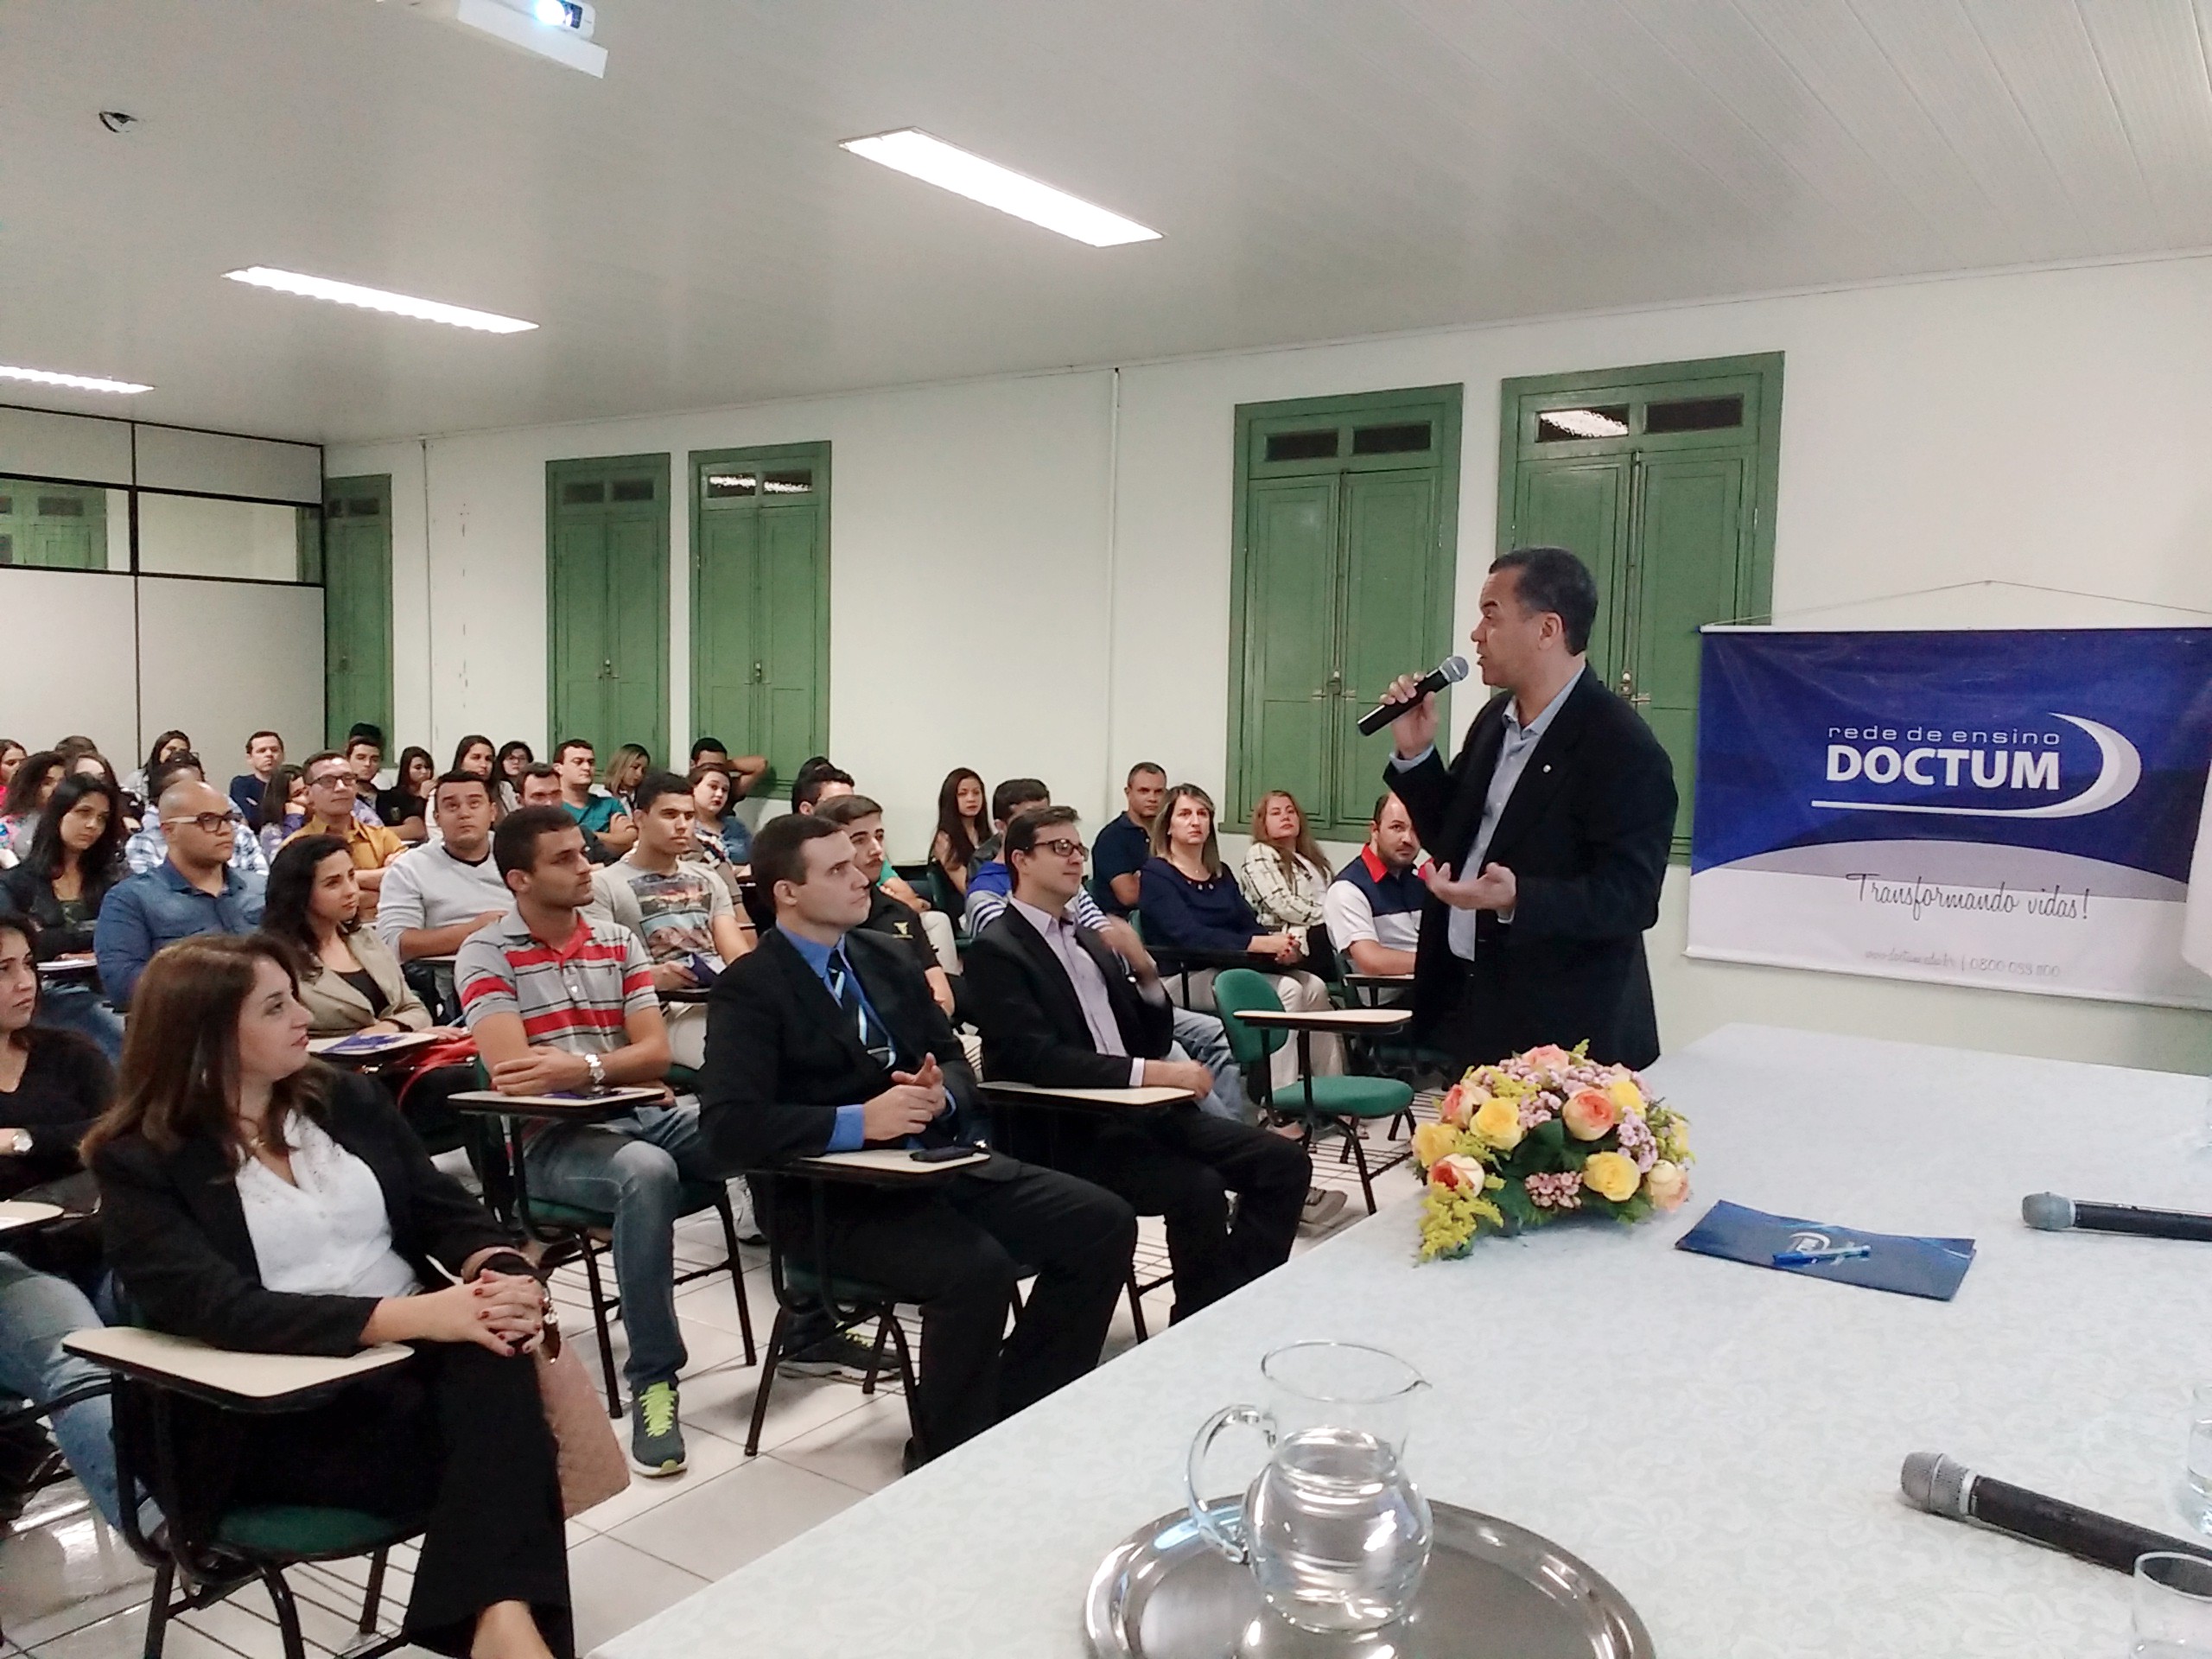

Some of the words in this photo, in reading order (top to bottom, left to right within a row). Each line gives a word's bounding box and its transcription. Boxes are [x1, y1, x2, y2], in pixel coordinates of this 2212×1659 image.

[1828, 726, 1897, 741] rede
[1907, 727, 1942, 741] de
[1952, 728, 2060, 745] ensino
[1827, 744, 2060, 790] DOCTUM
[1846, 873, 2018, 921] Transformando
[2028, 885, 2090, 919] vidas!
